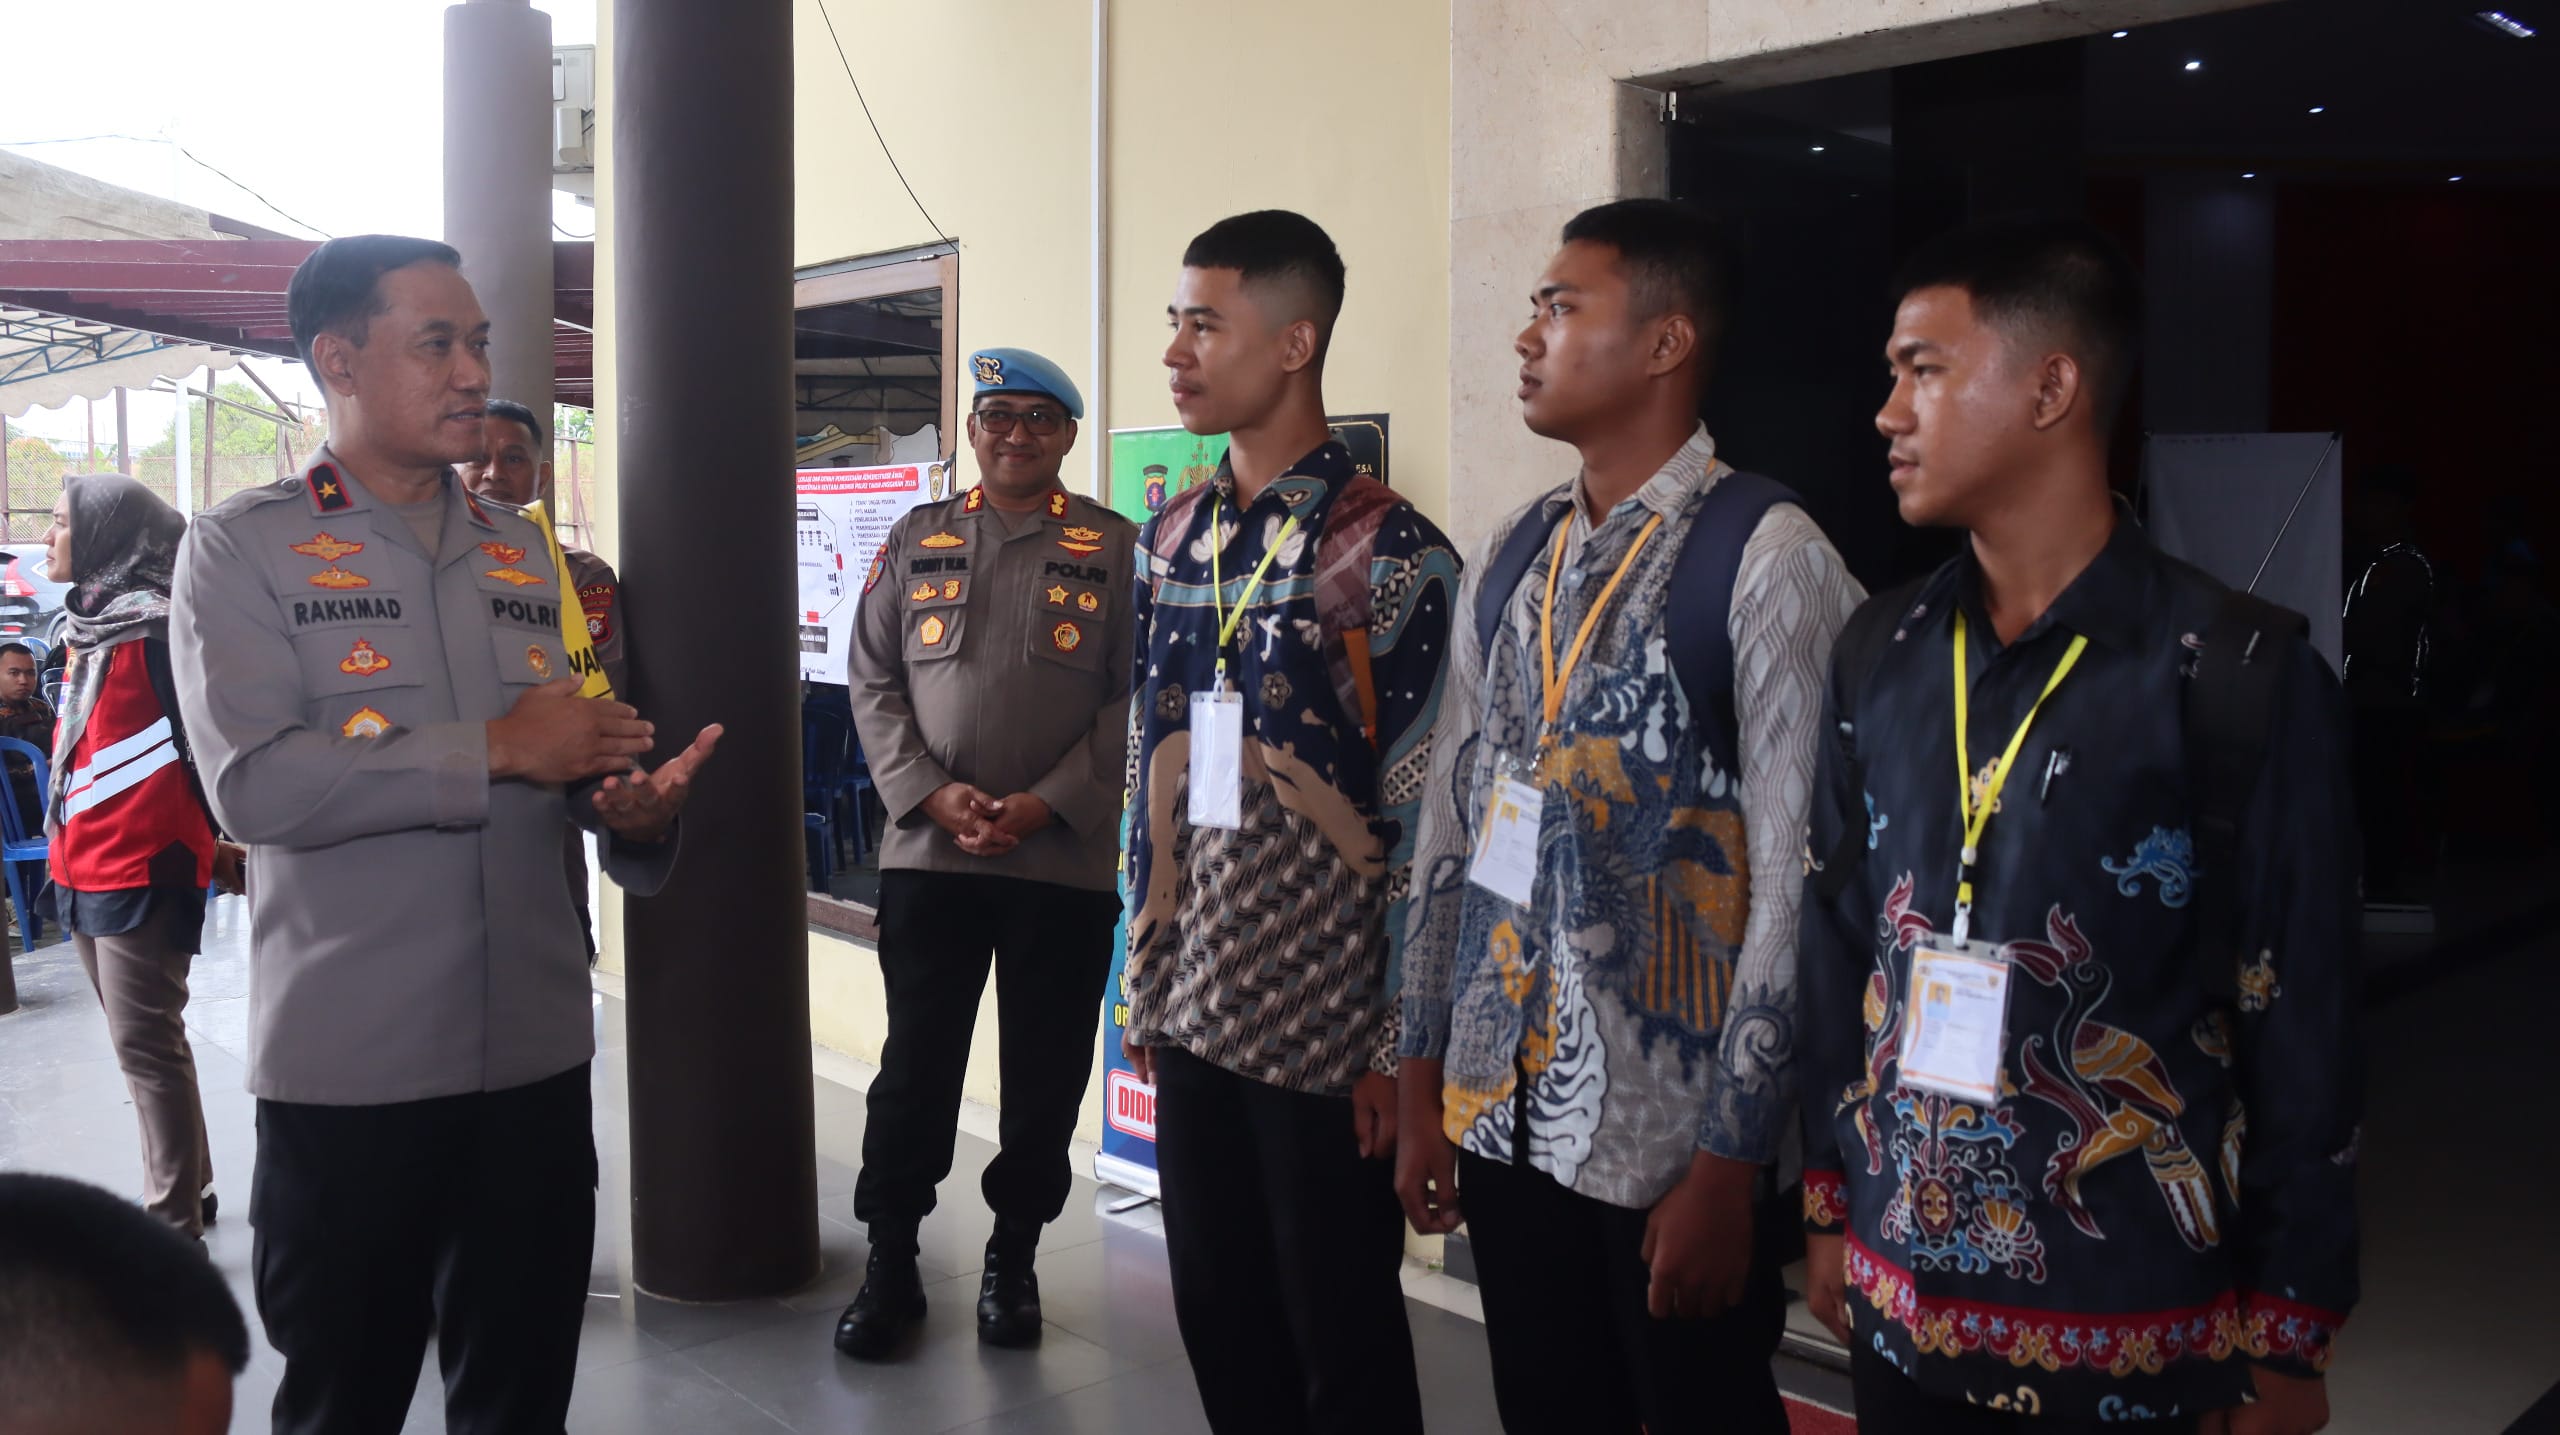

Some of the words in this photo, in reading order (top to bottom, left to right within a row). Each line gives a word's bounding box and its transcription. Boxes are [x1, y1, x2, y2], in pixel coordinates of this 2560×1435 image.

[1044, 560, 1108, 585] POLRI
[579, 586, 611, 599] OLDA
[294, 597, 402, 627] RAKHMAD
[491, 597, 558, 629] POLRI
[1118, 1085, 1157, 1126] DIDI
